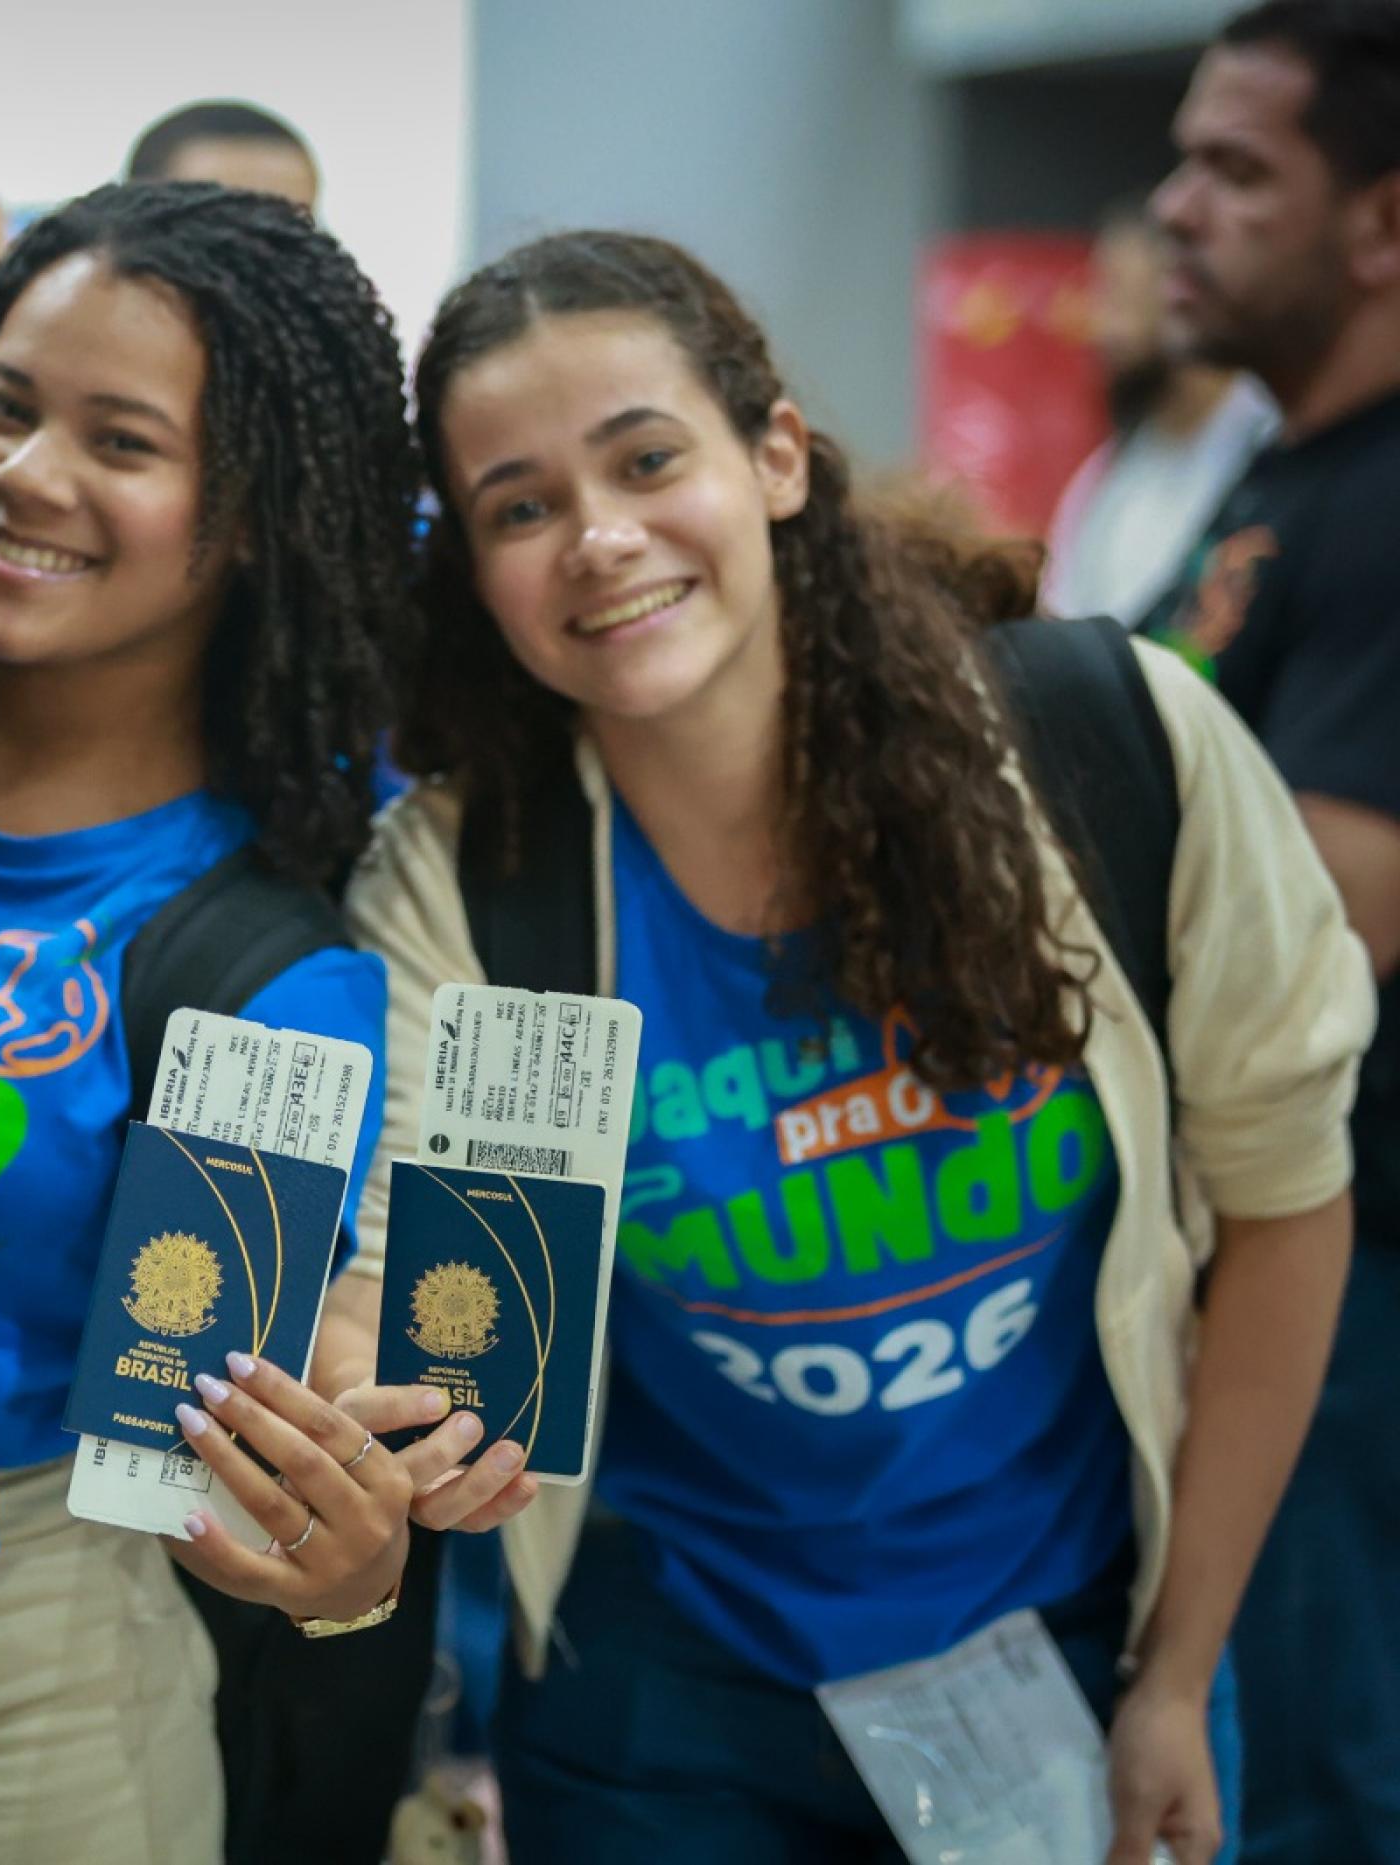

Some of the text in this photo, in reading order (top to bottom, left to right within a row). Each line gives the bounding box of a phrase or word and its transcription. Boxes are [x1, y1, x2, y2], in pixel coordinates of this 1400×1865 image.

[516, 1003, 526, 1040] AEREAS
[436, 1040, 448, 1089] IBERIA
[511, 1046, 522, 1081] LINEAS
[161, 1069, 178, 1118] IBERIA
[290, 1068, 308, 1104] 43E
[780, 1094, 880, 1163] pra
[206, 1156, 254, 1176] MERCOSUL
[467, 1189, 514, 1202] MERCOSUL
[691, 1278, 1038, 1416] 2026
[115, 1355, 192, 1391] BRASIL
[112, 1412, 175, 1435] PASSAPORTE
